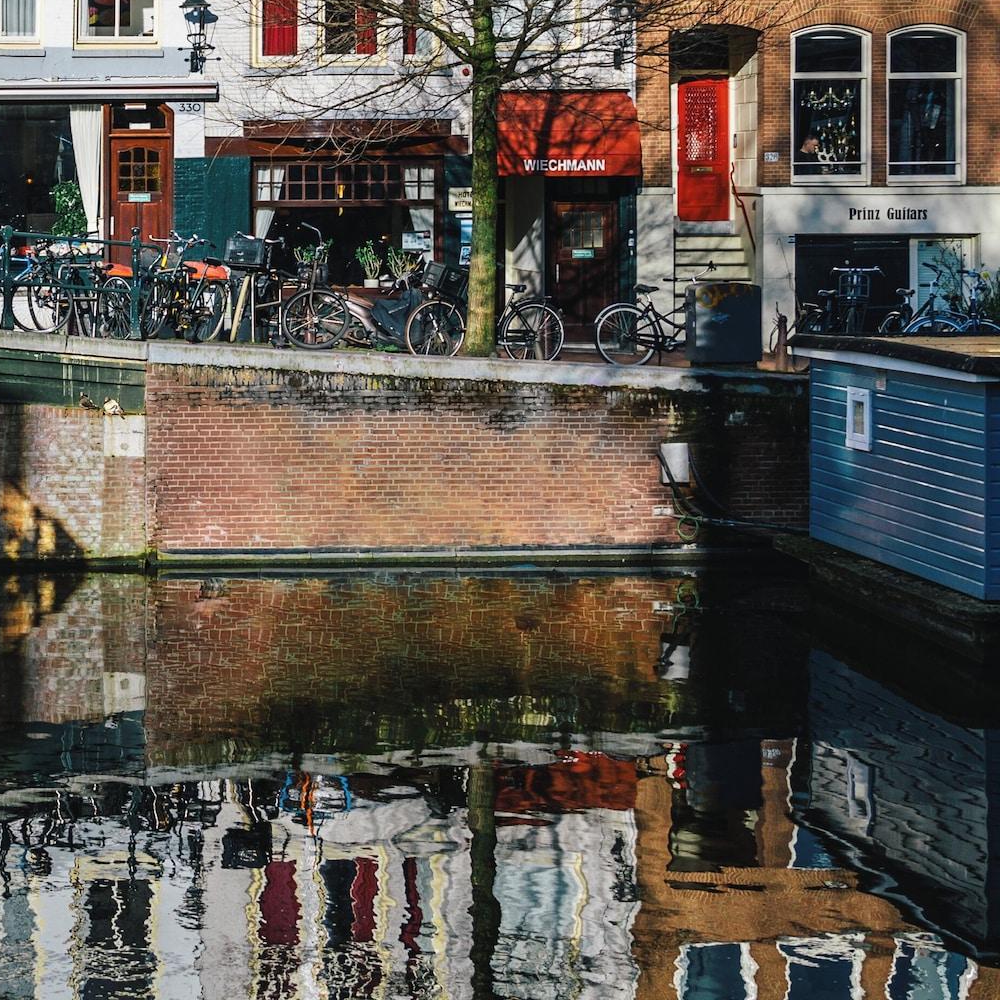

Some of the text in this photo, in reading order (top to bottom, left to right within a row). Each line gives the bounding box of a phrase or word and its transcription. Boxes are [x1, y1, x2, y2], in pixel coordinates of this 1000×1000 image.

[178, 103, 202, 112] 330
[523, 159, 606, 172] WIECHMANN
[849, 207, 928, 221] Prinz Guitars
